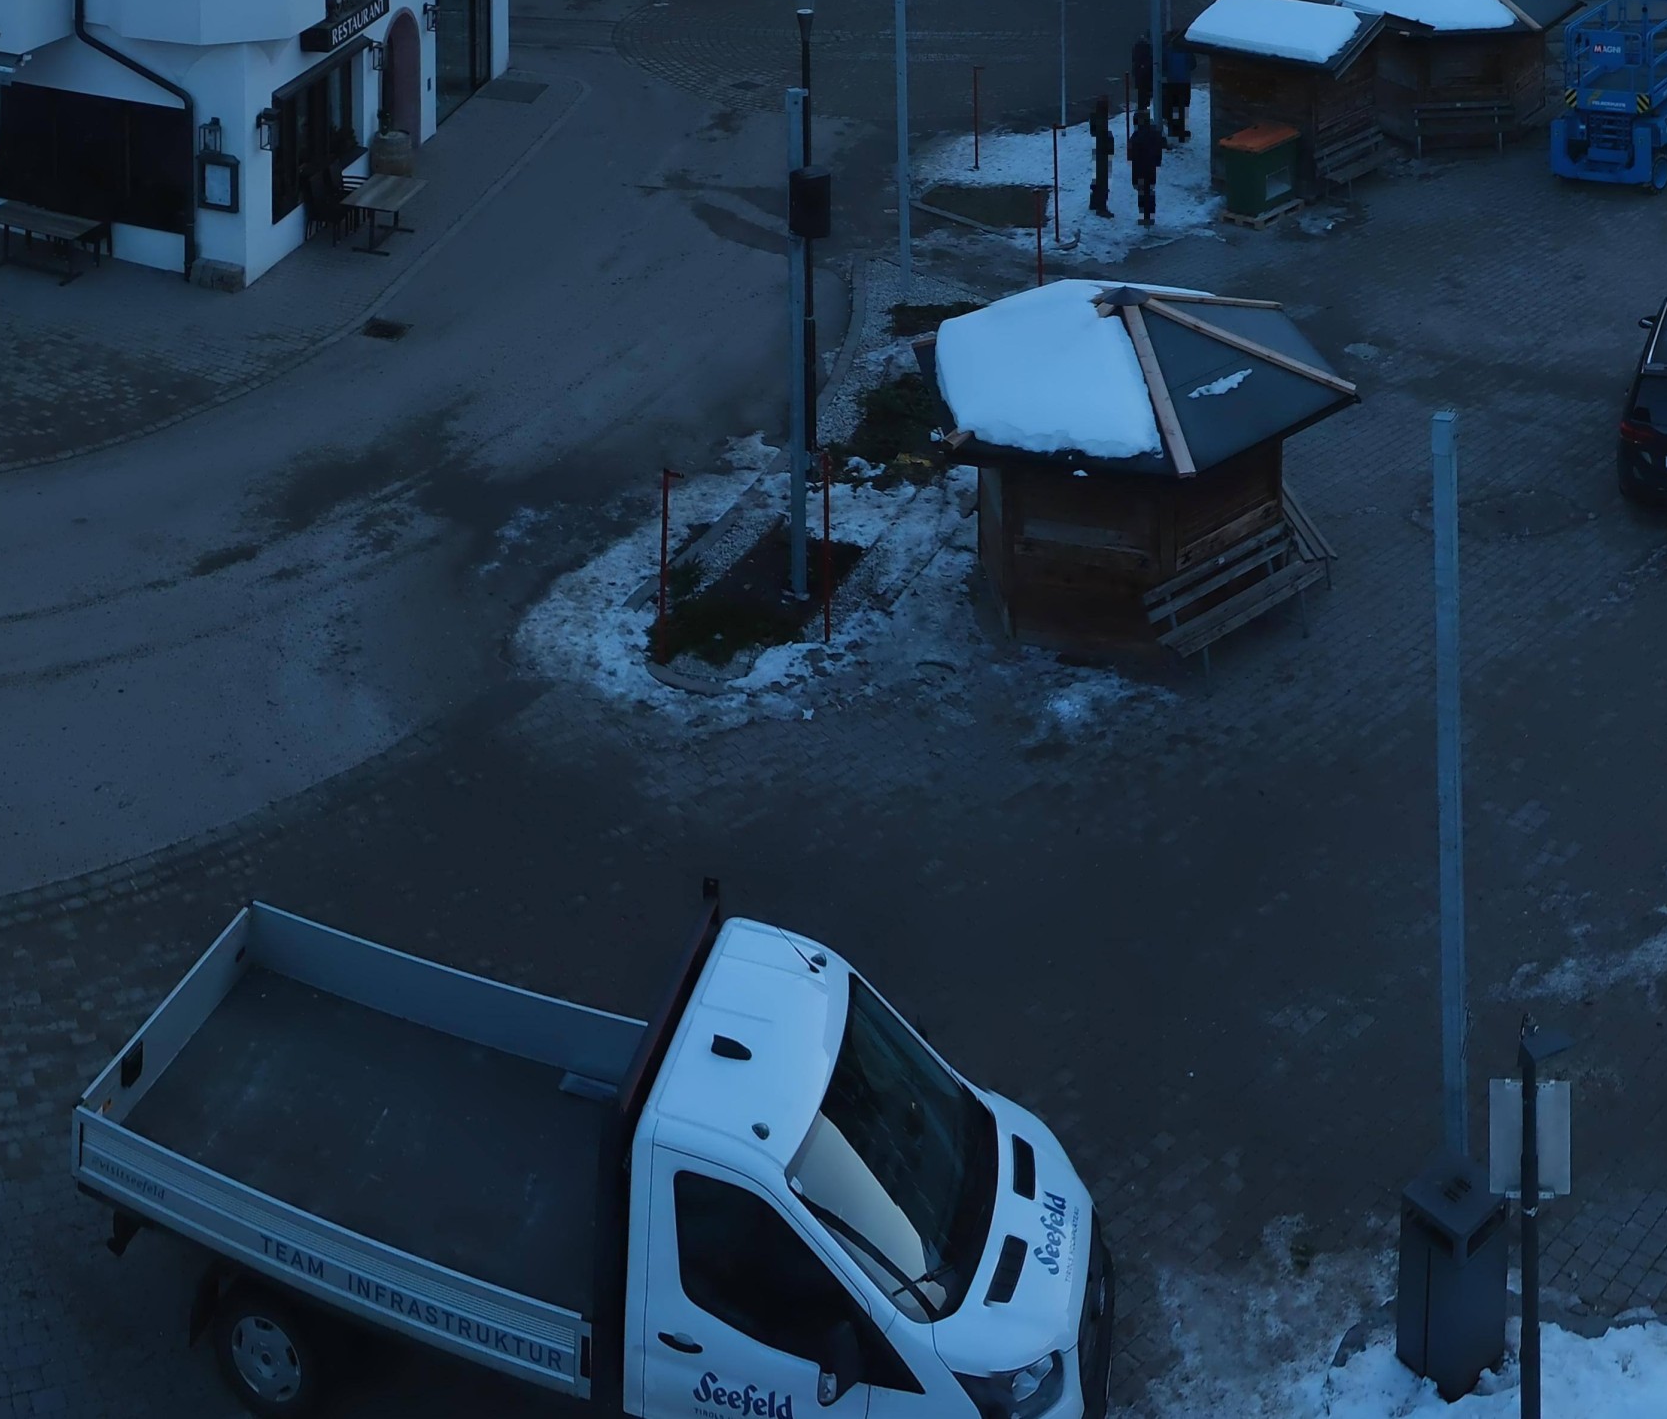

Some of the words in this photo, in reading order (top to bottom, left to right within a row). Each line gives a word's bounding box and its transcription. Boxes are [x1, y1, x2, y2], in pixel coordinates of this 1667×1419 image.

[1593, 45, 1622, 54] MAGNI
[1033, 1190, 1067, 1275] Seefeld
[260, 1234, 324, 1279] TEAM
[347, 1273, 563, 1371] INFRASTRUKTUR
[693, 1371, 793, 1419] Seefeld
